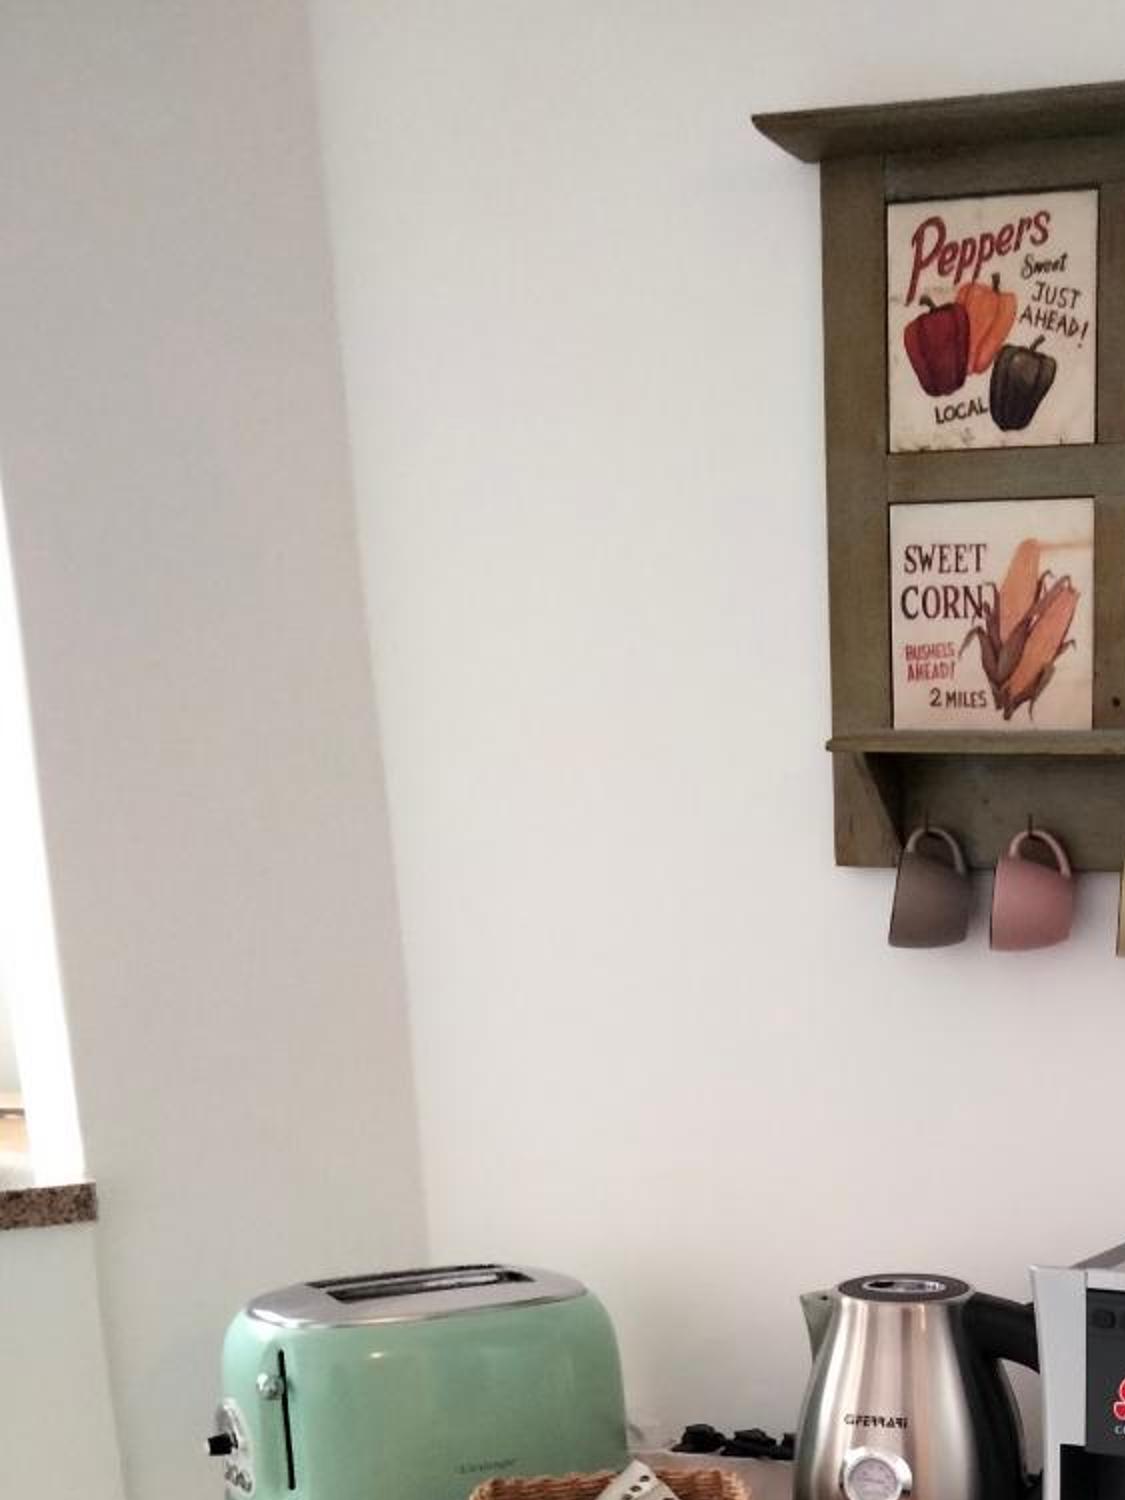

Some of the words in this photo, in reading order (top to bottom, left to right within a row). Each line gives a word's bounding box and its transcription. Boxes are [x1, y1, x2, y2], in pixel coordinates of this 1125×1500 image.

[904, 209, 1051, 307] Peppers
[1031, 280, 1082, 309] JUST
[1020, 306, 1089, 349] AHEAD!
[934, 396, 989, 425] LOCAL
[903, 543, 987, 575] SWEET
[900, 583, 985, 621] CORN
[929, 687, 942, 707] 2
[945, 689, 987, 708] MILES
